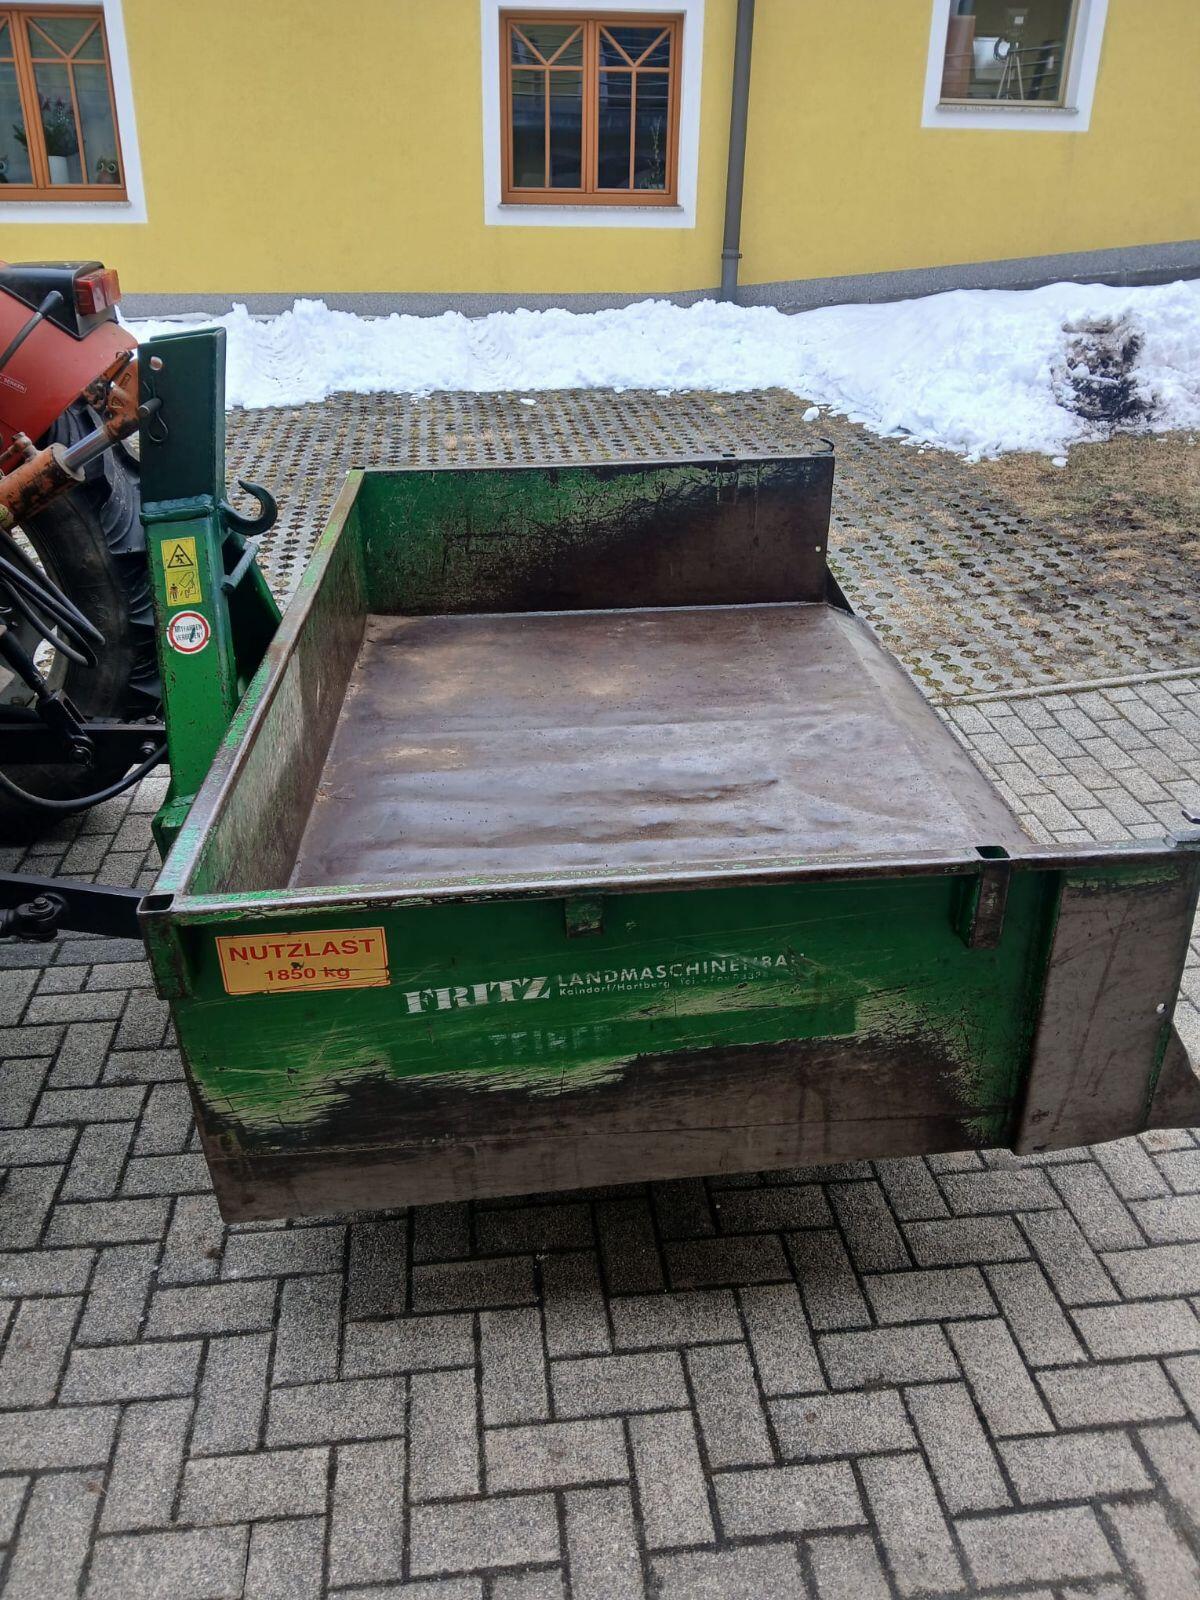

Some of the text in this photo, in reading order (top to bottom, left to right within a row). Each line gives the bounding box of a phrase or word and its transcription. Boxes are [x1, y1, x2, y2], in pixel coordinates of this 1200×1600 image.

[229, 938, 376, 962] NUTZLAST
[264, 964, 350, 982] 1850 kg
[403, 976, 551, 1014] FRITZ
